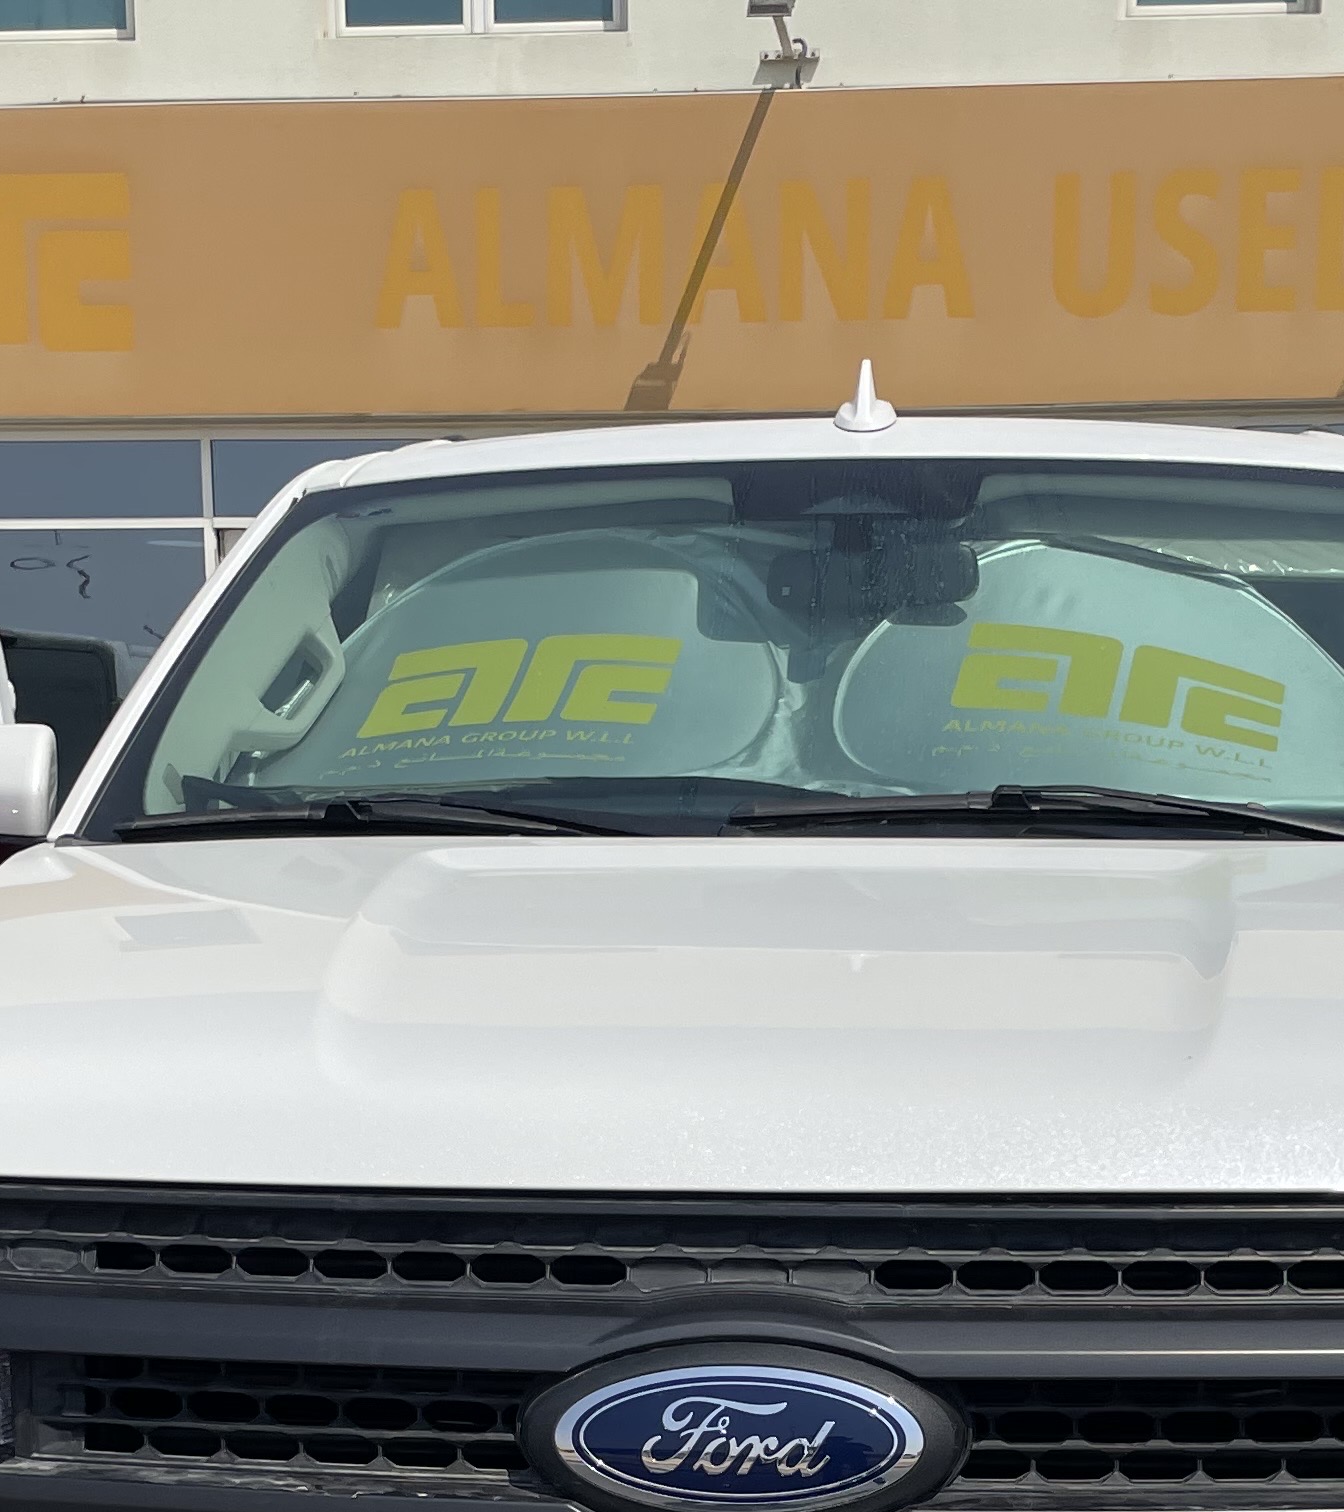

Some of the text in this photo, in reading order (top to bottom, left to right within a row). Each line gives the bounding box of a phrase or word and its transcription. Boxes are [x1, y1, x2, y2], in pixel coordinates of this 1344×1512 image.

[373, 174, 976, 330] ALMANA
[338, 735, 451, 759] ALMANA
[461, 728, 557, 744] GROUP
[641, 1396, 836, 1476] Ford
